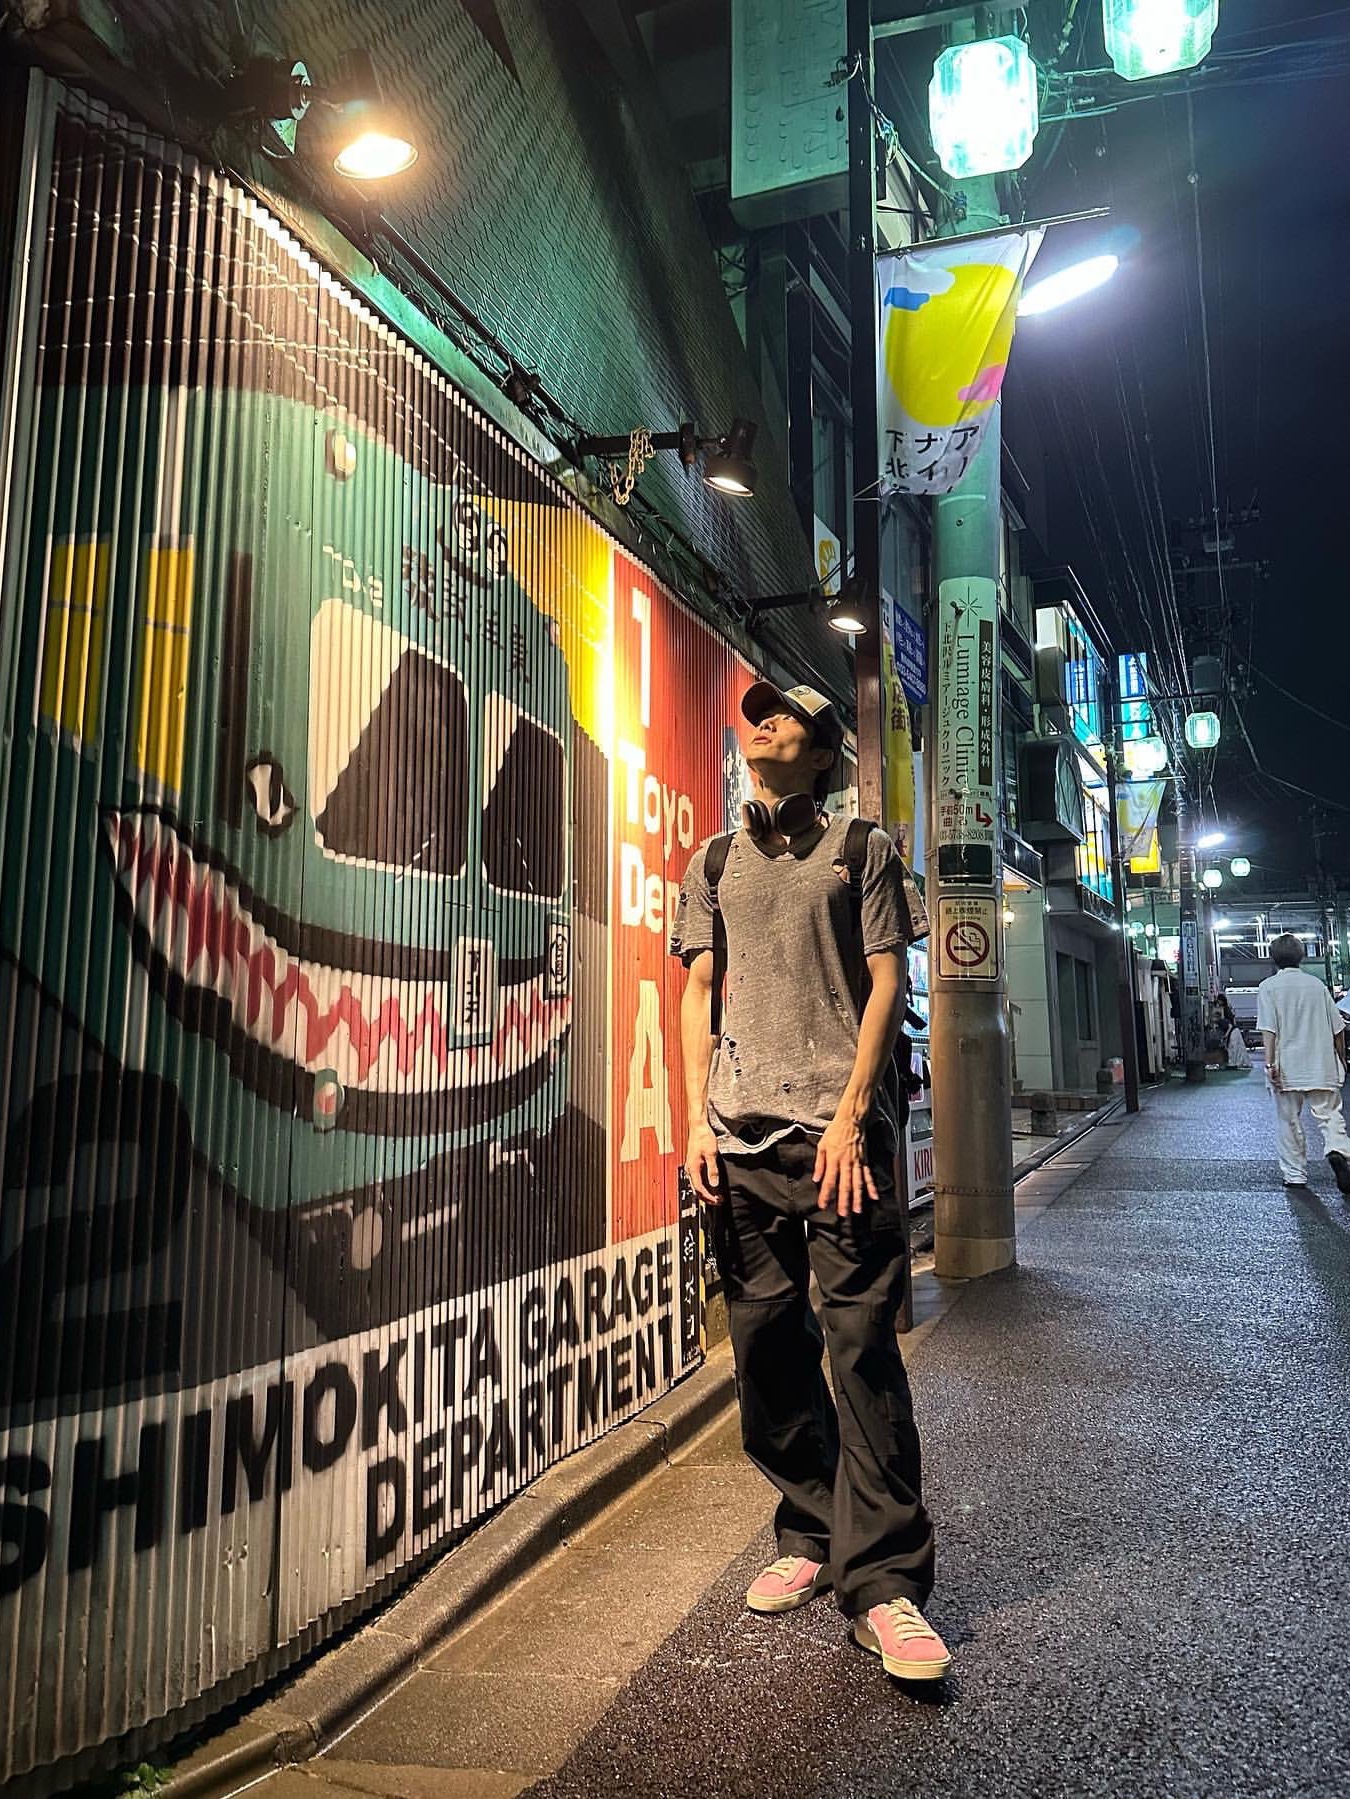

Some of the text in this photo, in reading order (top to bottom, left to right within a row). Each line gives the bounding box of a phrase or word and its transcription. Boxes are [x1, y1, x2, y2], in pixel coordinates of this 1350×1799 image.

[952, 633, 976, 720] Lumiage
[619, 738, 694, 861] Toyo
[954, 726, 975, 785] Clinic
[619, 979, 674, 1163] A
[914, 1147, 932, 1181] KIRI
[0, 1306, 500, 1597] SHIMOKITA
[521, 1240, 674, 1367] GARAGE
[366, 1315, 677, 1568] DEPARTMENT
